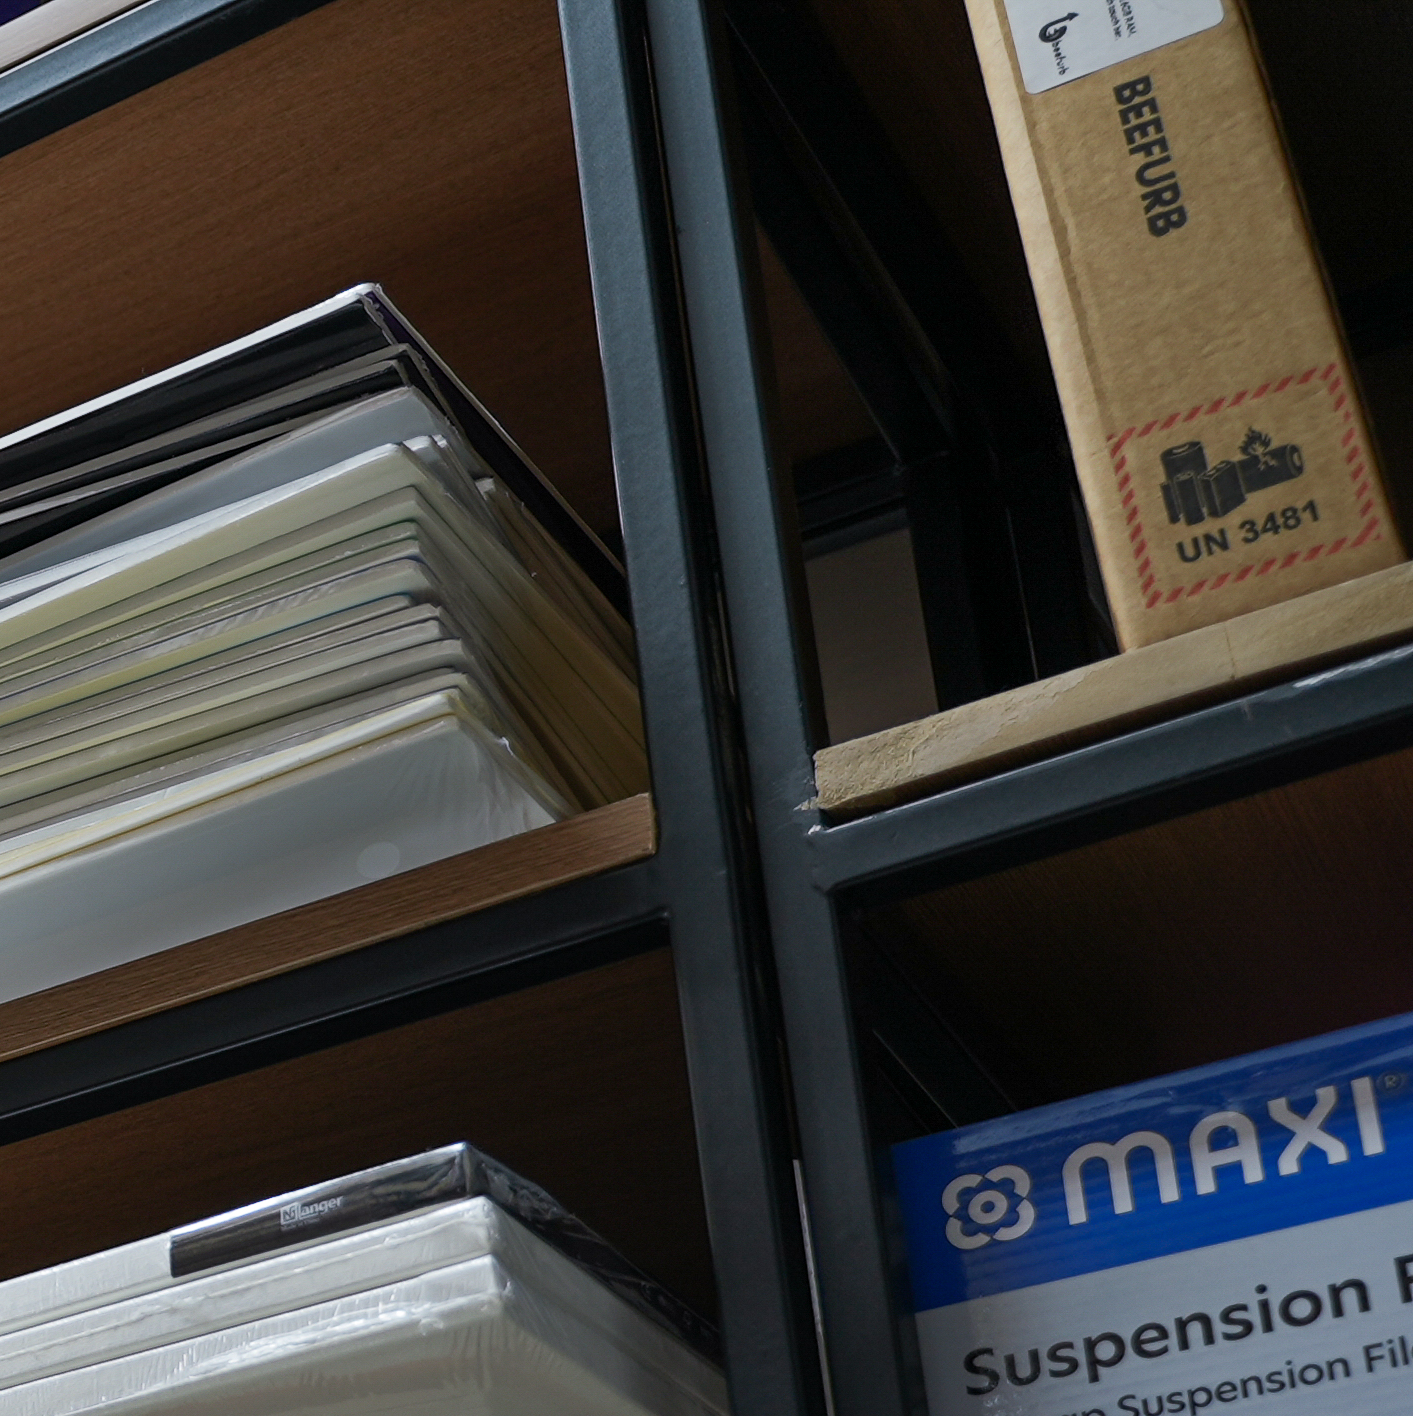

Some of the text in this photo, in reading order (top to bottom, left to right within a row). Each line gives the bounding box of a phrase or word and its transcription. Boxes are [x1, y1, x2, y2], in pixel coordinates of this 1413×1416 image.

[1112, 74, 1187, 237] BEEFURB
[1176, 499, 1322, 564] UN 3481
[1060, 1076, 1387, 1227] MAXI
[962, 1273, 1372, 1397] Suspension
